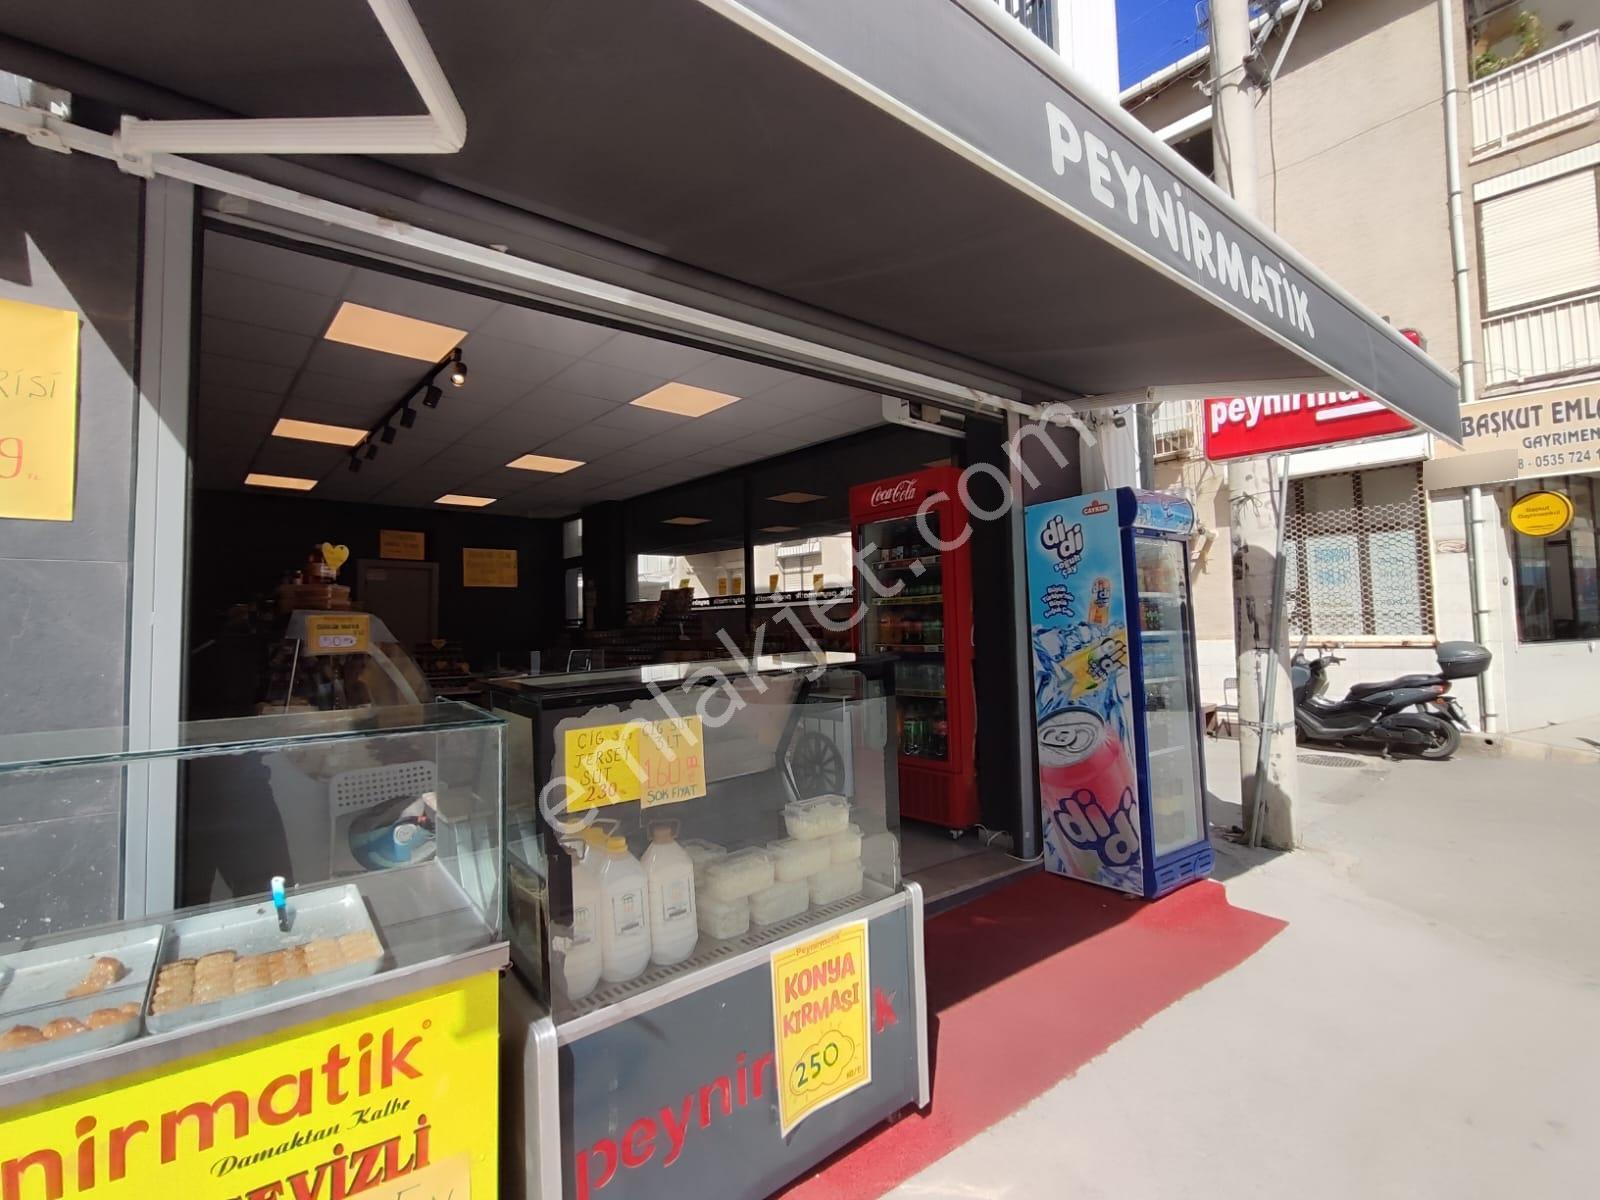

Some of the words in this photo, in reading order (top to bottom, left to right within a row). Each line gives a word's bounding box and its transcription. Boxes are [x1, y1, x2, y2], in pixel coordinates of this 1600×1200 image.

[1046, 102, 1315, 338] PEYNİRMATİK
[1461, 404, 1543, 438] BAŞKUT
[1535, 453, 1565, 468] 0535
[1569, 450, 1591, 463] 724
[784, 952, 855, 1003] KONYA
[796, 1043, 838, 1087] 250
[210, 1124, 341, 1177] Damaktan
[346, 1097, 410, 1131] Kalbe
